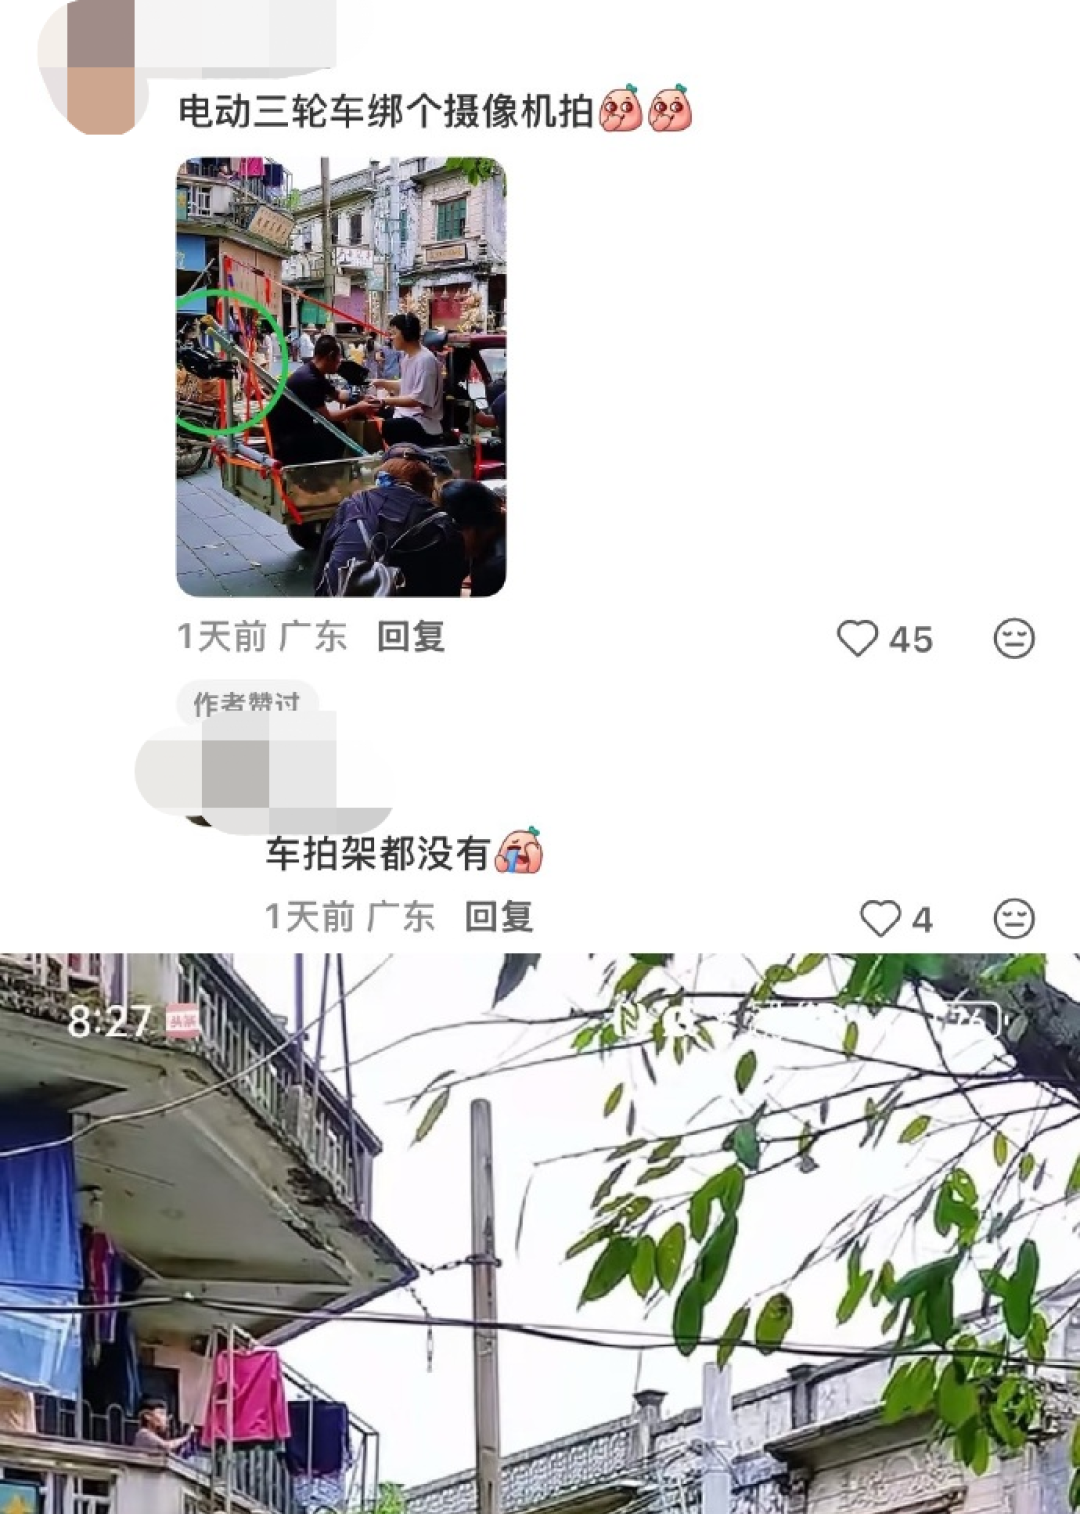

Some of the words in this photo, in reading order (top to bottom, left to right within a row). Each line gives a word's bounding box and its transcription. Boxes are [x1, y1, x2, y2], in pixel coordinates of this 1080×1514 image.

[178, 91, 594, 130] 电动三轮车绑个摄像机拍
[178, 619, 267, 653] 1天前
[279, 619, 347, 653] 广东
[378, 619, 446, 654] 回复
[888, 625, 934, 654] 45
[265, 834, 492, 872] 车拍架都没有
[265, 899, 355, 933] 1天前
[367, 899, 435, 933] 广东
[465, 899, 534, 934] 回复
[911, 906, 934, 934] 4
